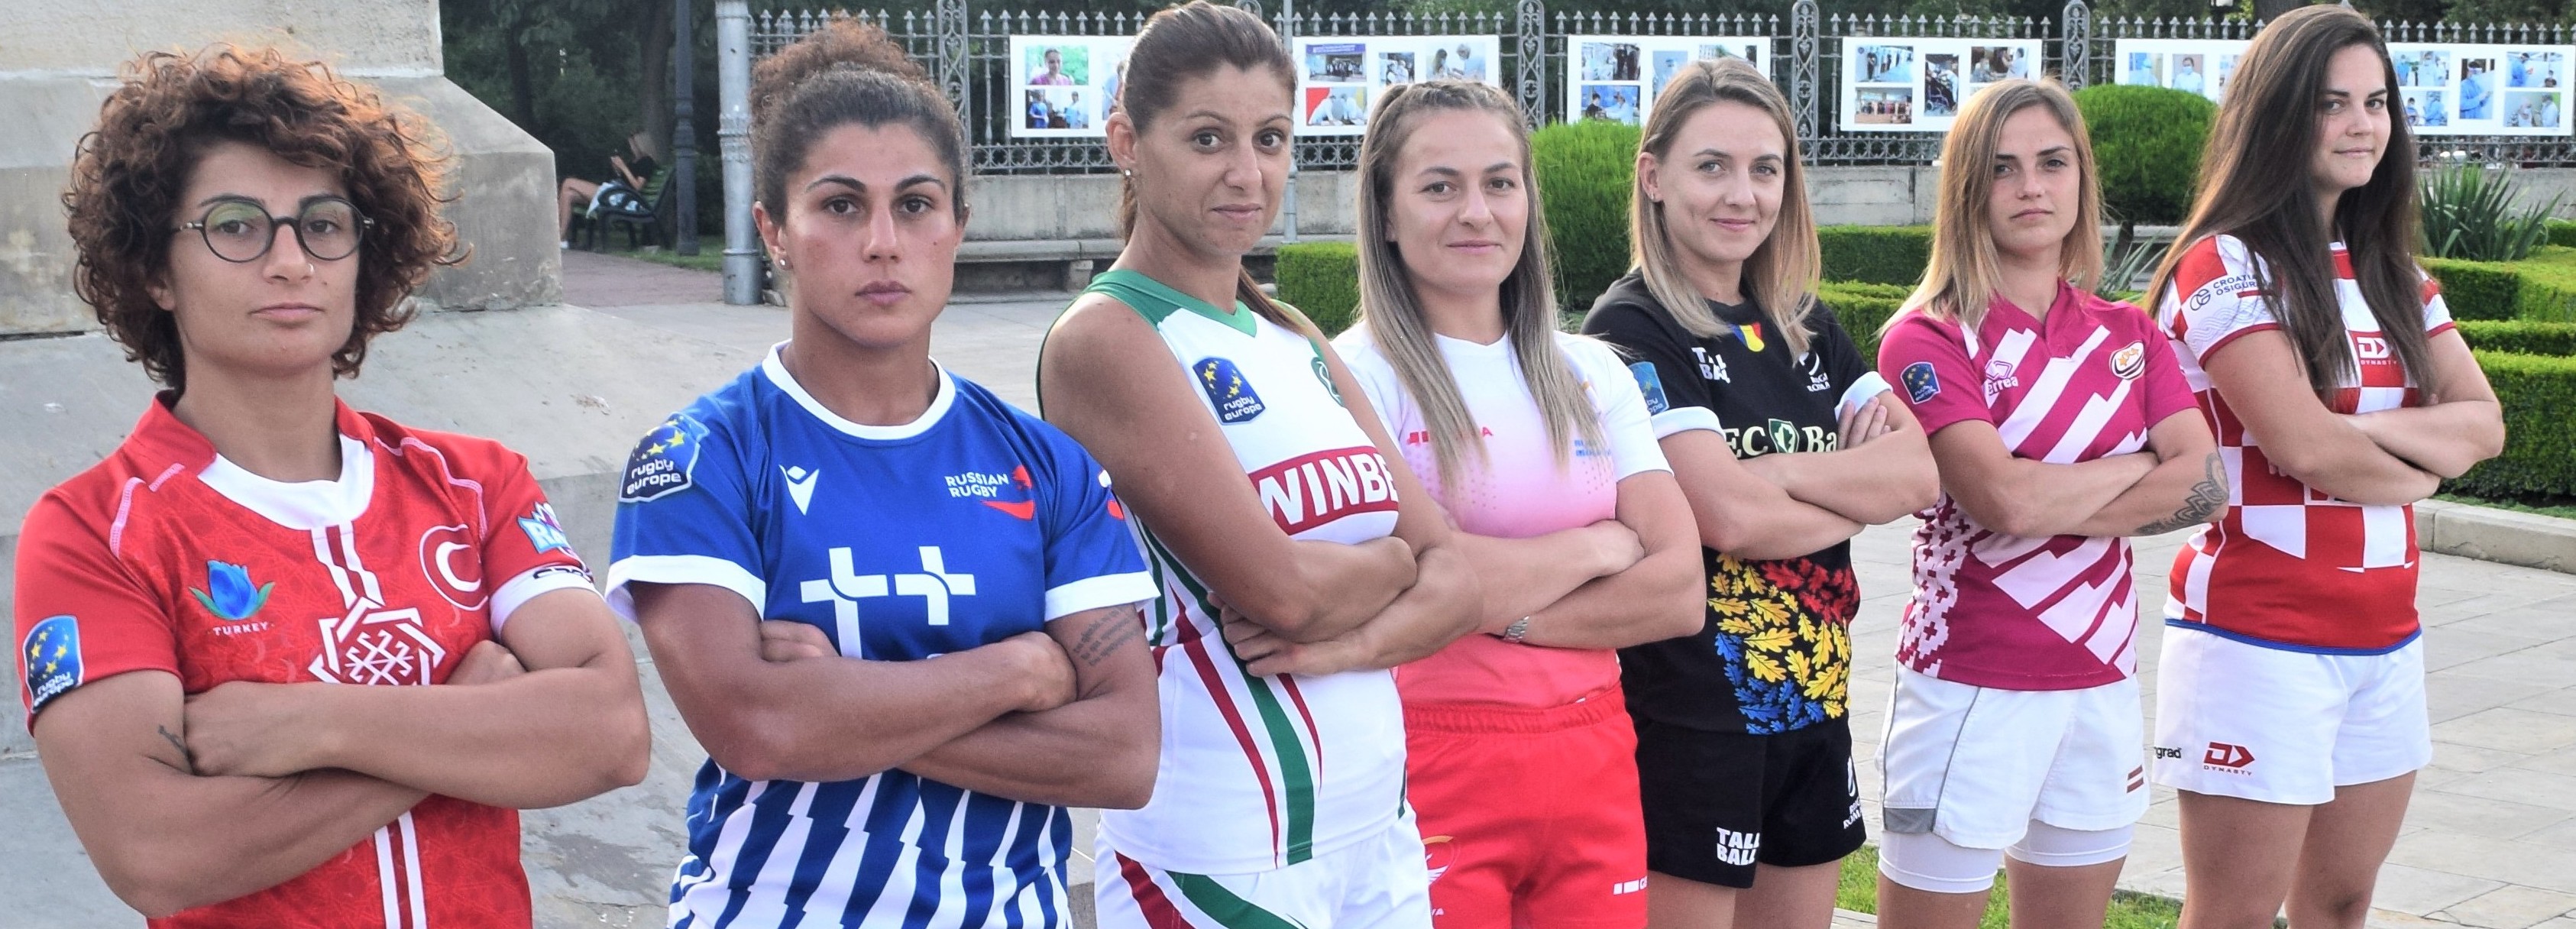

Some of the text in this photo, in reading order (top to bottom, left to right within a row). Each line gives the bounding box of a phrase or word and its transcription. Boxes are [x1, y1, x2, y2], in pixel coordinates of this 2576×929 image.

[1223, 396, 1255, 411] rugby
[1224, 403, 1263, 421] europe
[631, 458, 674, 479] rugby
[626, 472, 681, 495] europe
[944, 471, 1009, 487] RUSSIAN
[948, 483, 998, 498] RUGBY
[212, 620, 269, 636] TURKEY
[2203, 765, 2252, 776] DYNASTY
